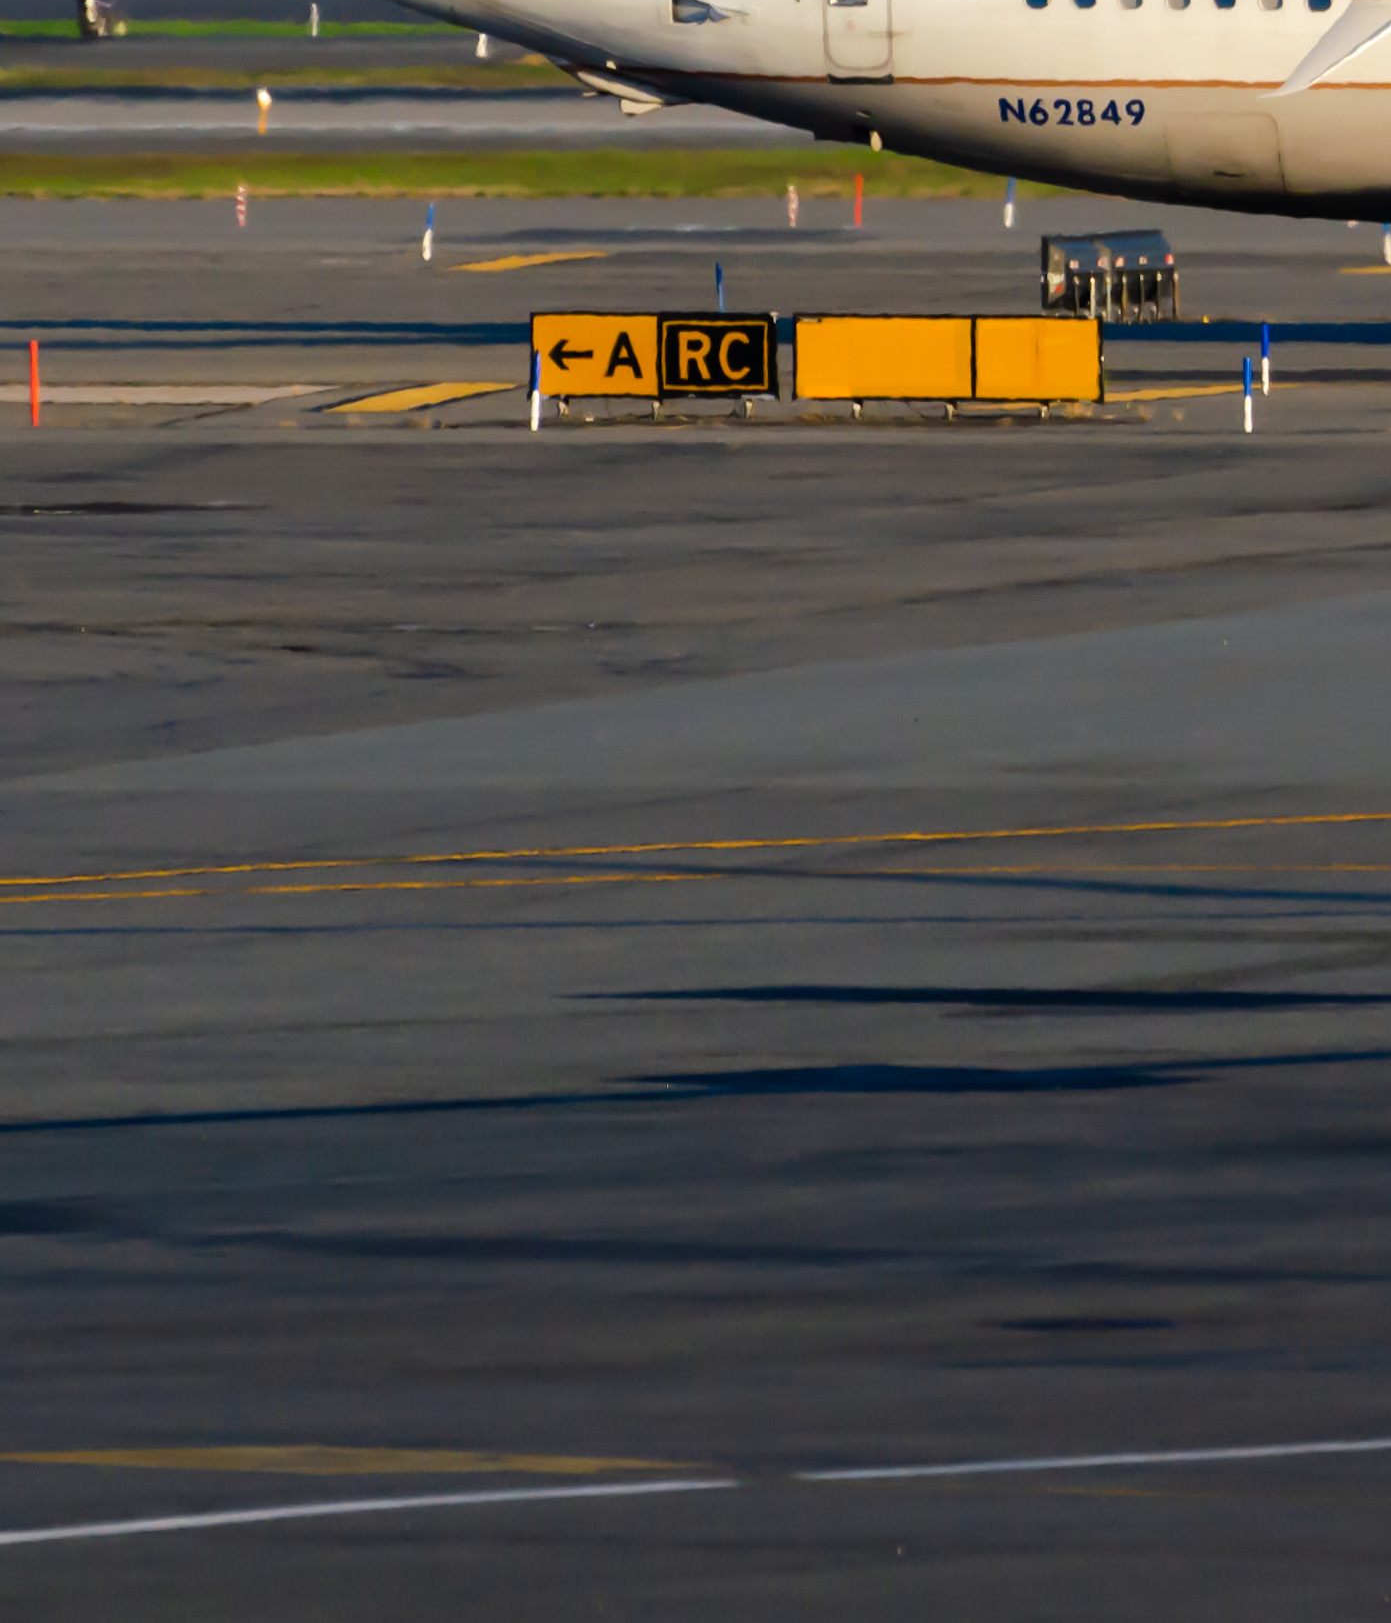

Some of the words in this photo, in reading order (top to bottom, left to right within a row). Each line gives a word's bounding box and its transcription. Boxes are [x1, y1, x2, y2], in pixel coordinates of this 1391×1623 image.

[998, 97, 1146, 126] N62849
[604, 331, 644, 379] A
[678, 330, 751, 381] RC
